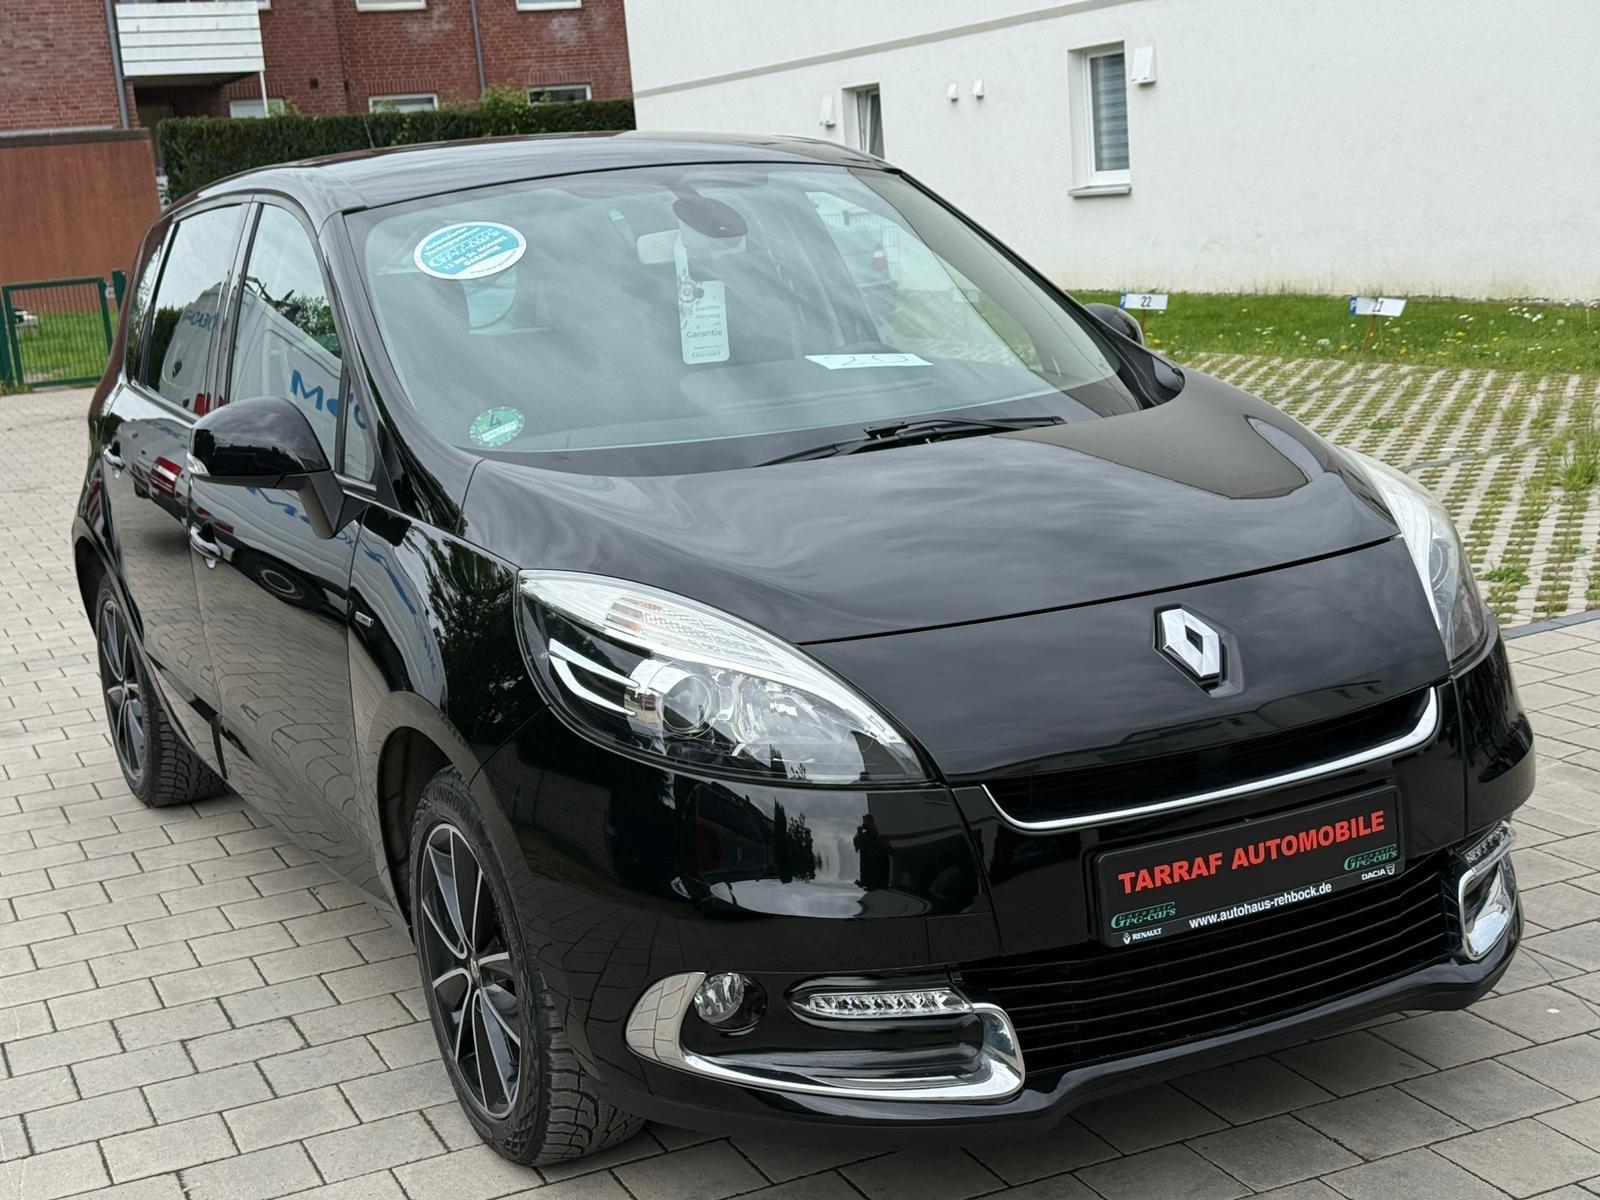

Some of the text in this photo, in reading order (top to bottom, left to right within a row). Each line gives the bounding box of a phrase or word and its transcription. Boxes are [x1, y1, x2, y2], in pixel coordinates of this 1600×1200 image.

[1141, 296, 1152, 307] 22
[686, 327, 722, 338] Garantie
[489, 413, 502, 428] 4
[1118, 810, 1385, 894] TARRAF AUTOMOBILE
[1361, 868, 1386, 880] DACIA
[1189, 882, 1332, 929] www.autohaus-rehbock.de
[1132, 927, 1162, 941] RENAULT
